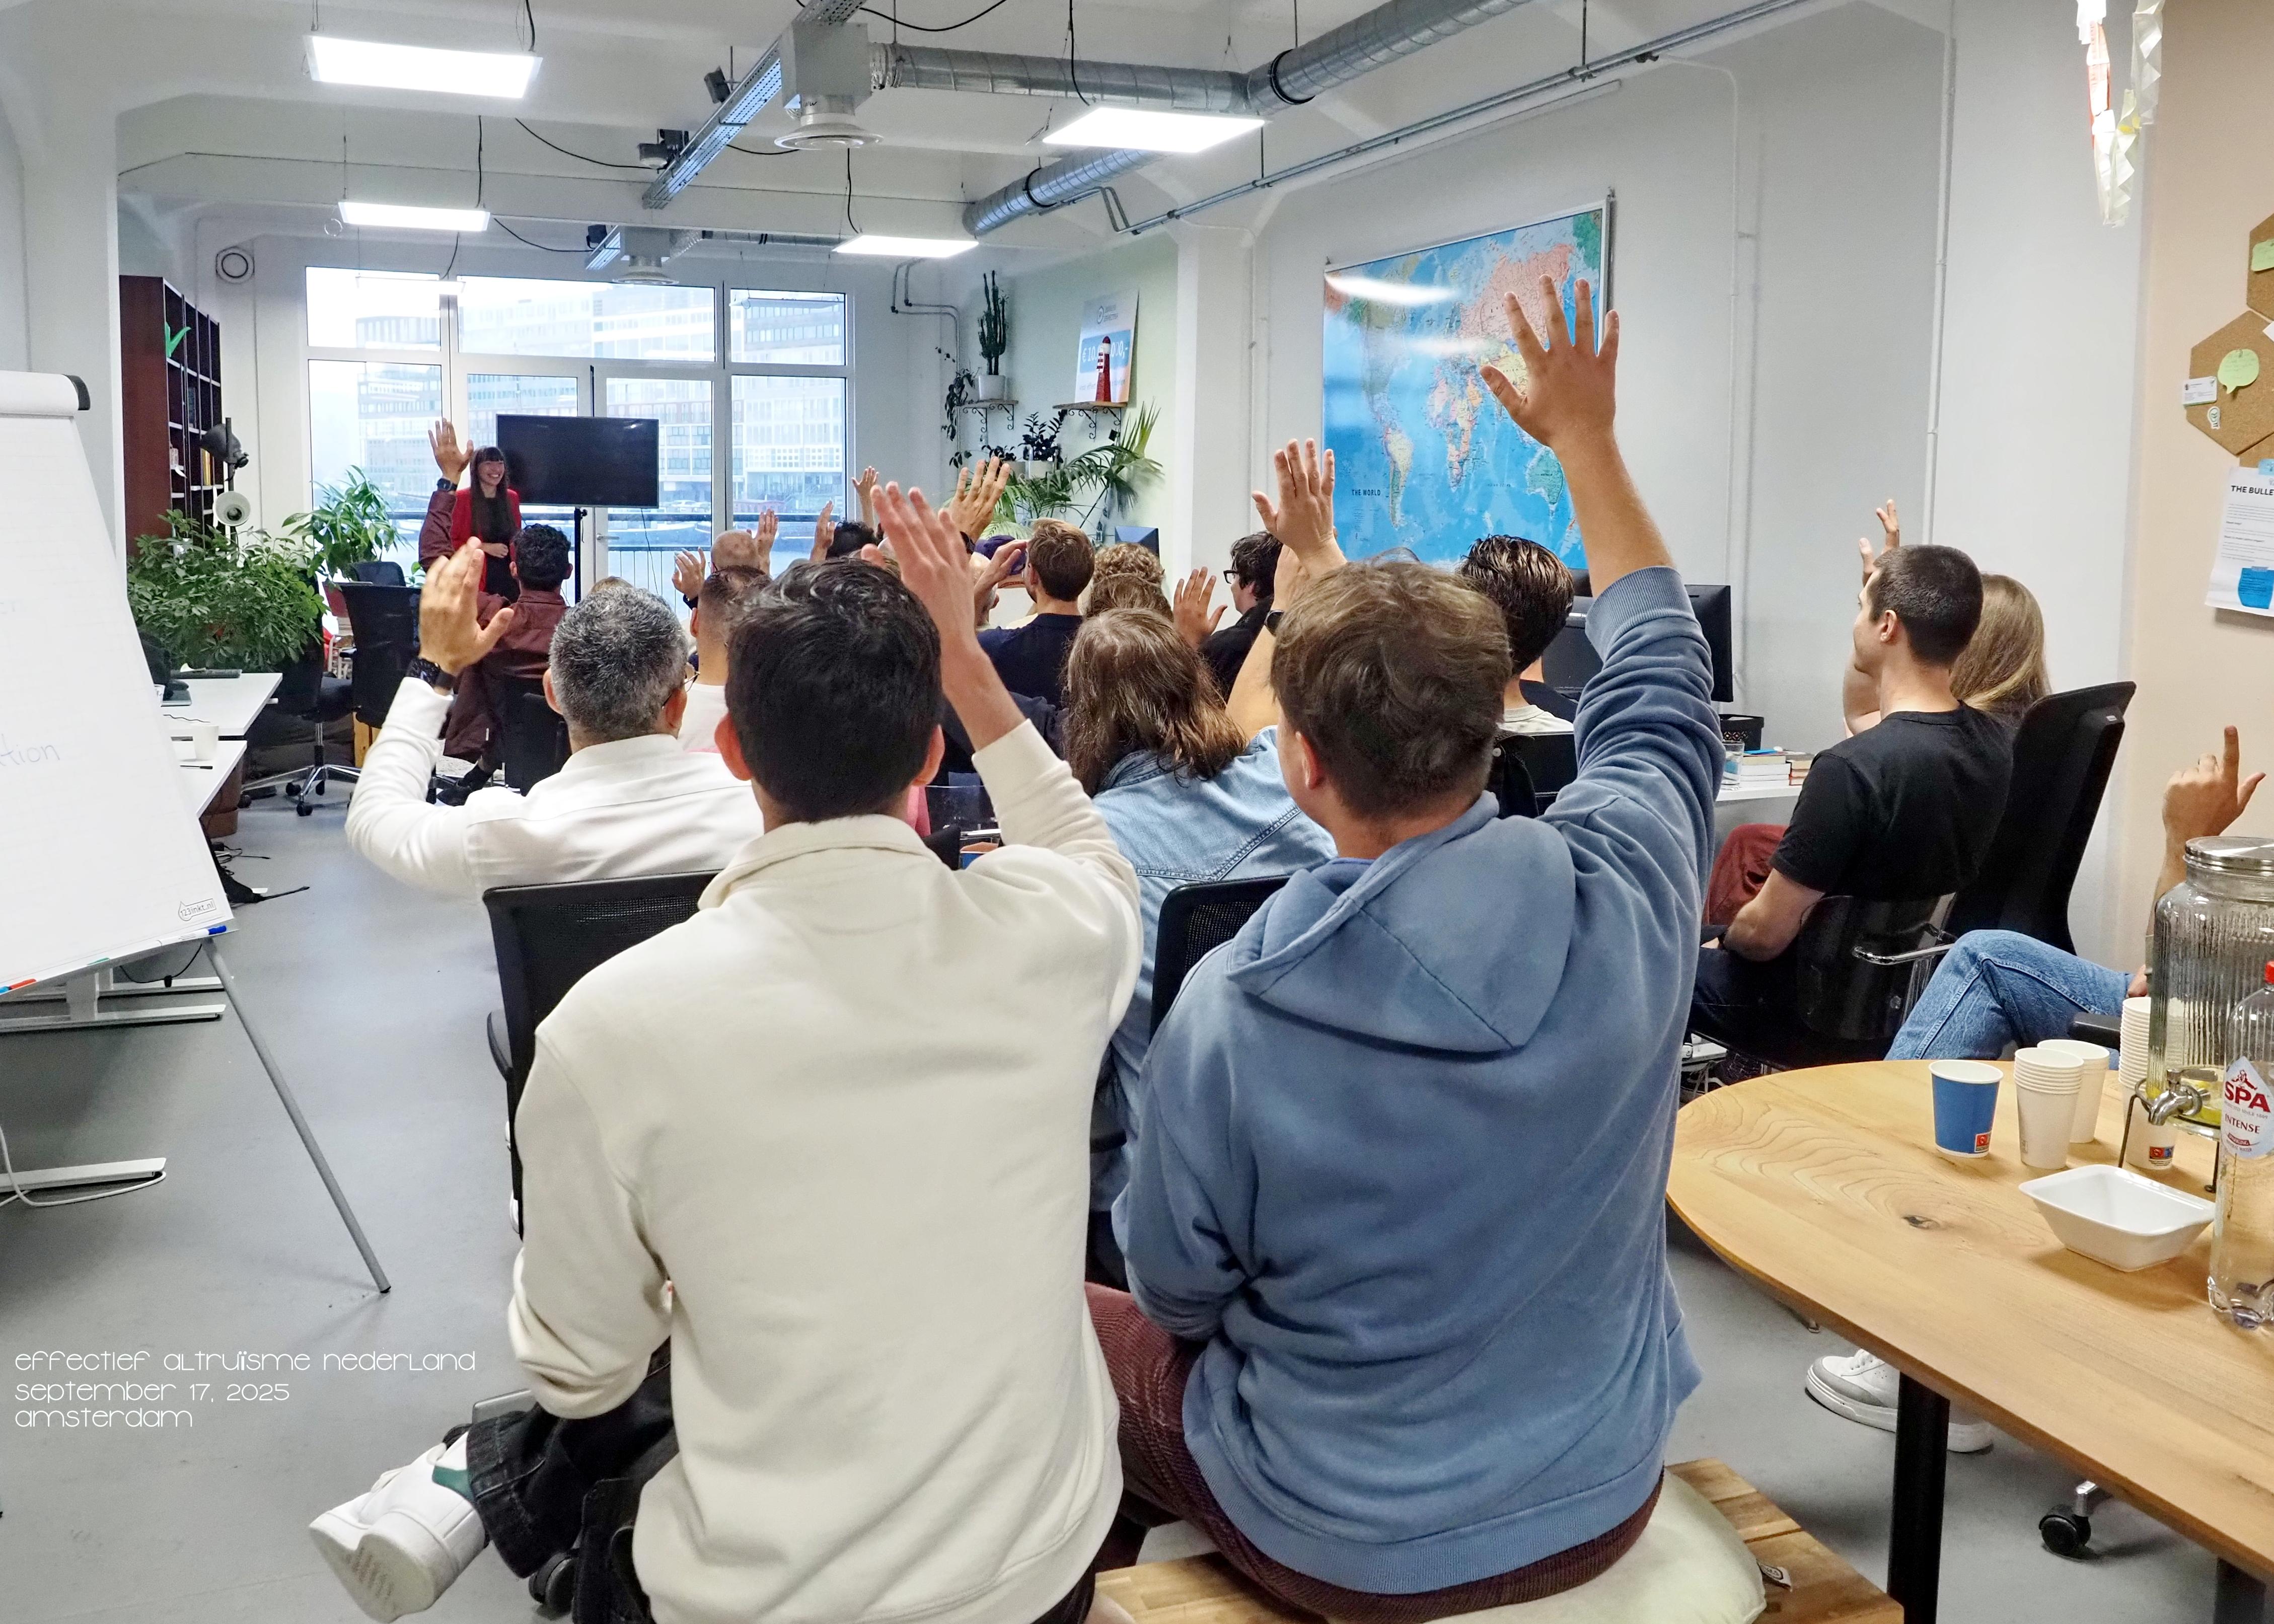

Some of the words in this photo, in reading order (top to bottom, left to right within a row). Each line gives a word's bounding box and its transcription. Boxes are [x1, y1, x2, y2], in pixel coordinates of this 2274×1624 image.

[180, 901, 214, 917] 123inkt.nl
[2225, 1081, 2270, 1113] SPA
[2225, 1114, 2260, 1134] INTENSE
